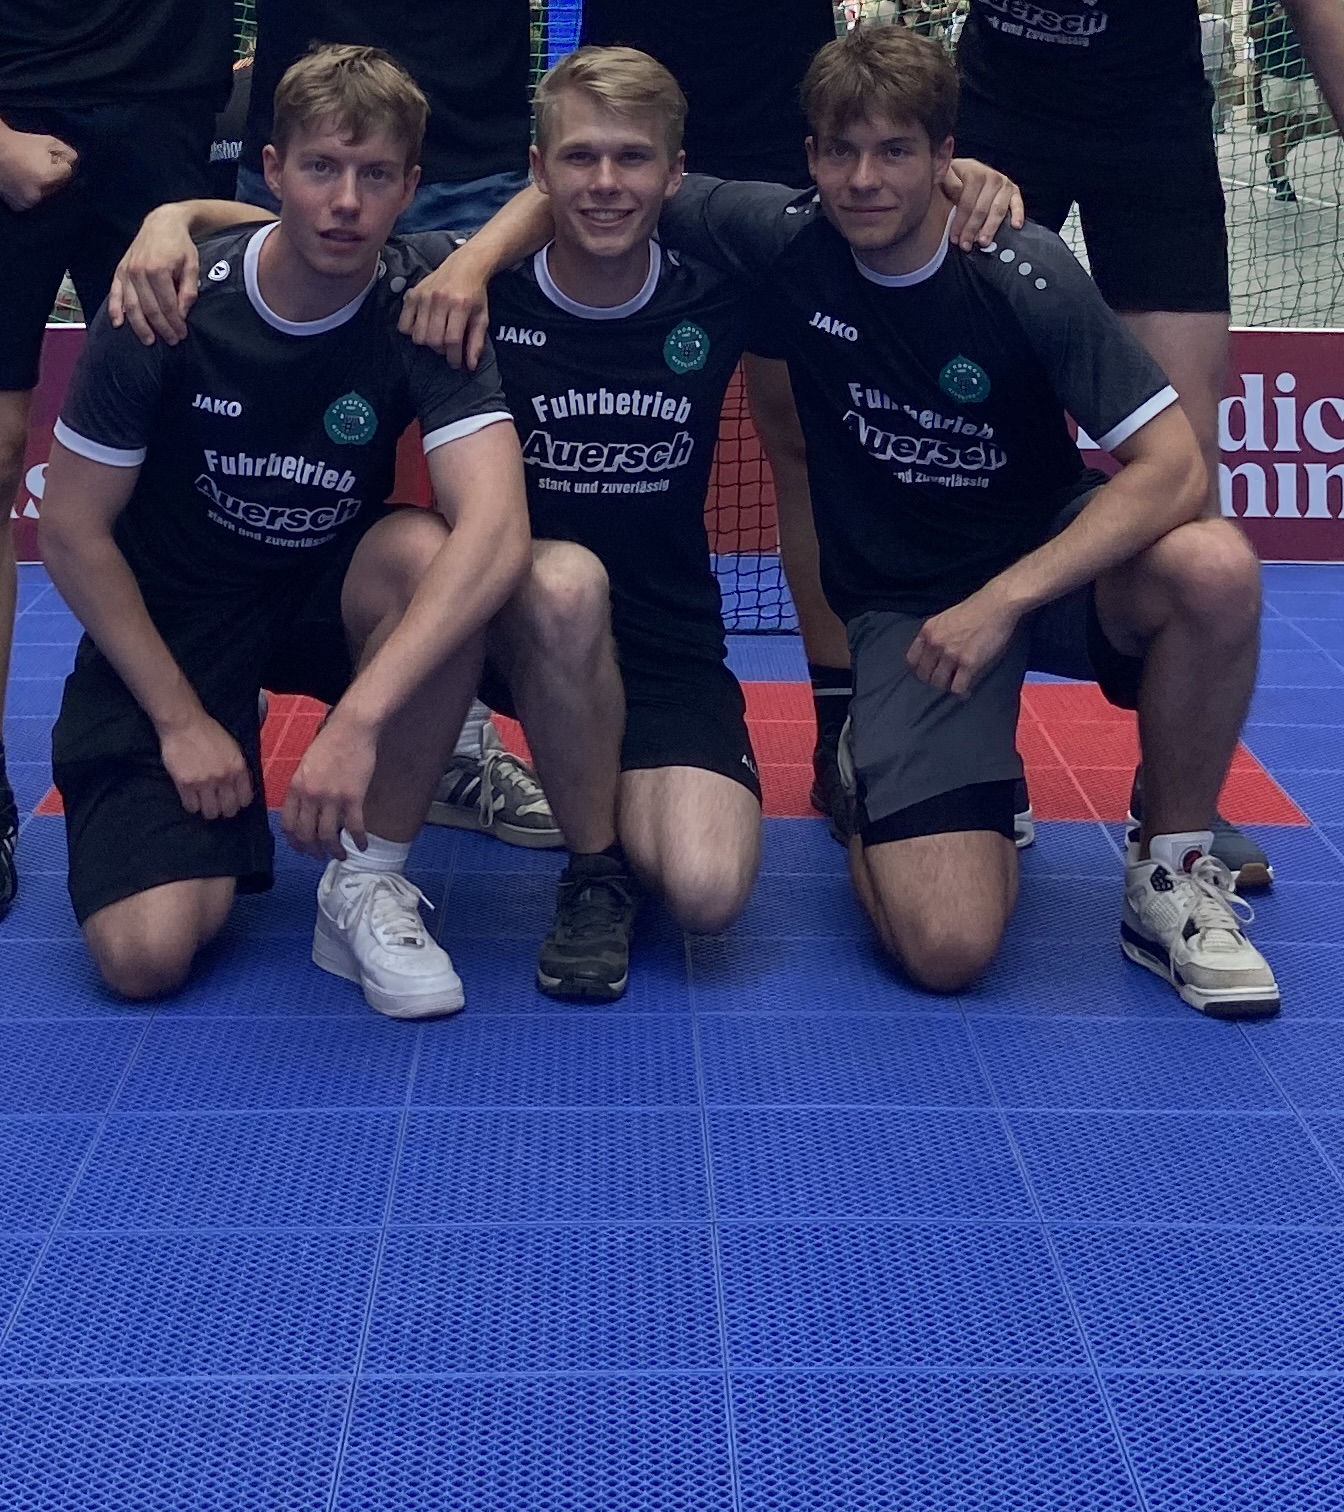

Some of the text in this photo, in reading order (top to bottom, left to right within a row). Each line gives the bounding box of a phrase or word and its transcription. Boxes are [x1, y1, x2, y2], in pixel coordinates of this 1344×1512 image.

[496, 325, 547, 347] JAKO
[808, 311, 859, 342] JAKO
[191, 393, 243, 418] JAKO
[531, 388, 692, 424] Fuhrbetrieb
[522, 430, 695, 474] Auersch
[204, 449, 357, 494] Fuhrbetrieb
[538, 476, 671, 495] stark und zuverlässig
[194, 473, 363, 533] Auersch
